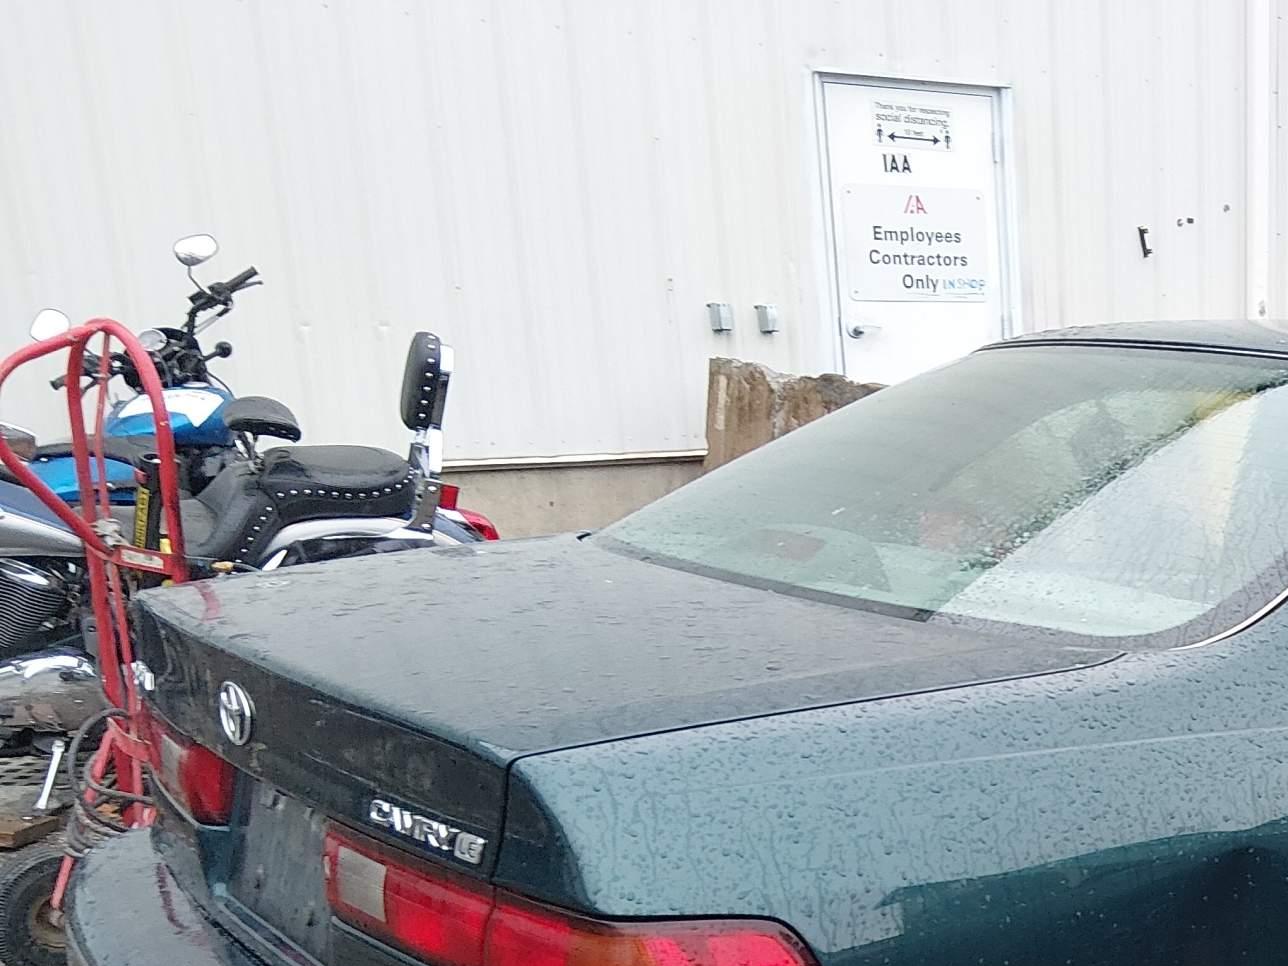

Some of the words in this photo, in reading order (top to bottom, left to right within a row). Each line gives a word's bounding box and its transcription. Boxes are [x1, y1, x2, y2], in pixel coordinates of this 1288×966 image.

[882, 153, 912, 173] IAA
[872, 225, 962, 246] Employees
[869, 249, 968, 267] Contractors
[902, 273, 939, 293] Only
